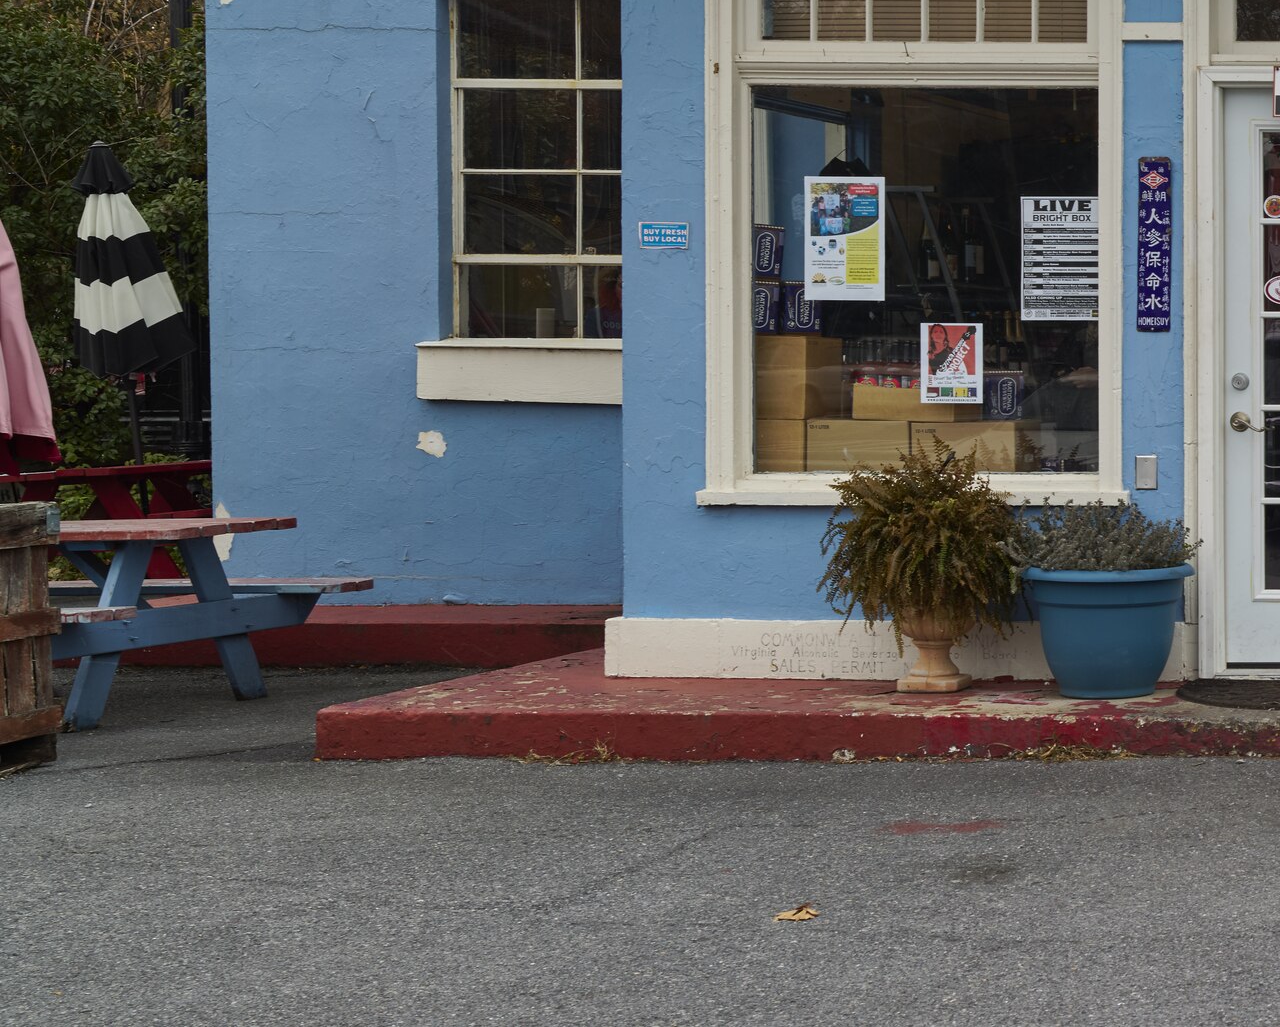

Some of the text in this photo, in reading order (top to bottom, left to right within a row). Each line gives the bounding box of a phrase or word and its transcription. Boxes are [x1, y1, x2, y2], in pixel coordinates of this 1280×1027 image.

[1032, 199, 1092, 212] LIVE
[1032, 214, 1092, 222] BRIGHT BOX
[661, 228, 688, 236] FRESH
[762, 236, 772, 268] NATIONAL
[757, 292, 766, 324] NATIONAL
[947, 341, 971, 372] PROJECT
